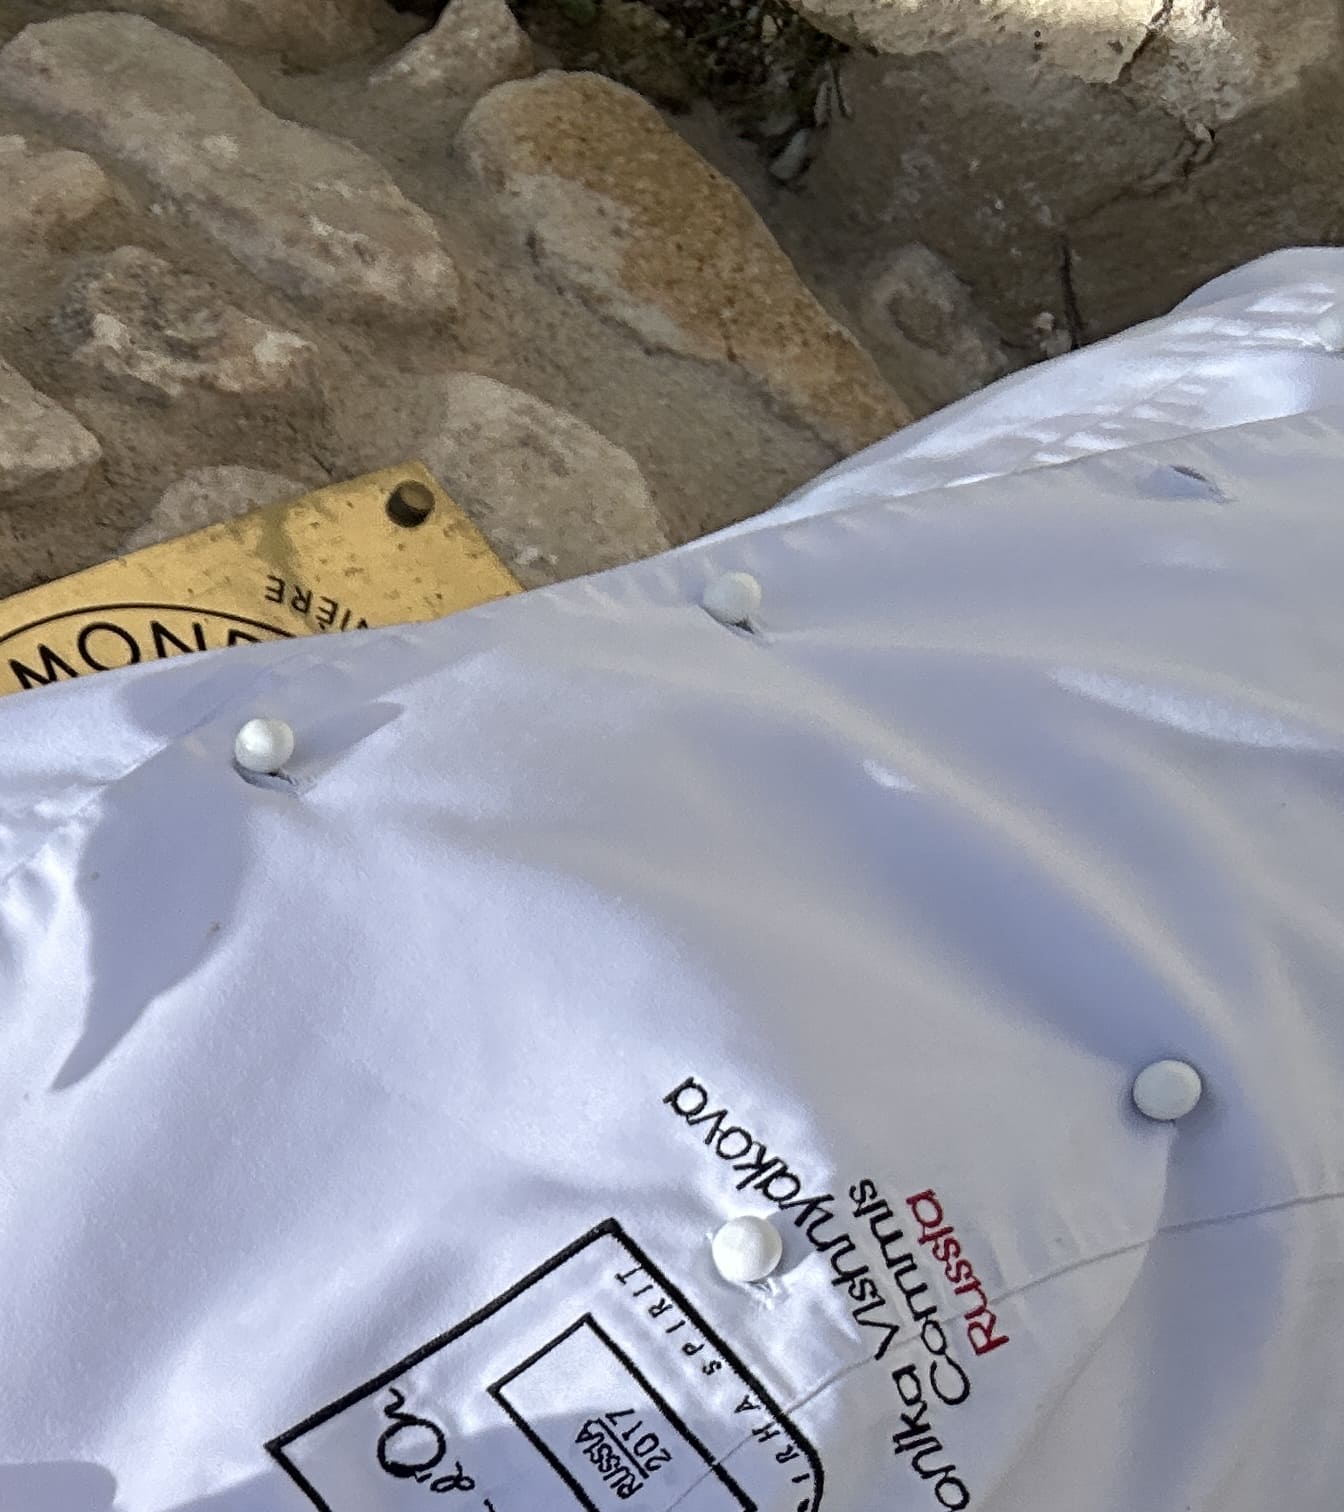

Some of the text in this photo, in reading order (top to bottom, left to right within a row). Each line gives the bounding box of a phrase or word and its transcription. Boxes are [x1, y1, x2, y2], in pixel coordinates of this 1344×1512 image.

[662, 1076, 901, 1362] Vishnyakova
[905, 1188, 1011, 1357] Russia
[615, 1262, 723, 1377] SPIRIT
[849, 1178, 972, 1407] Commis
[575, 1417, 645, 1501] RUSSIA
[605, 1408, 673, 1473] 2017
